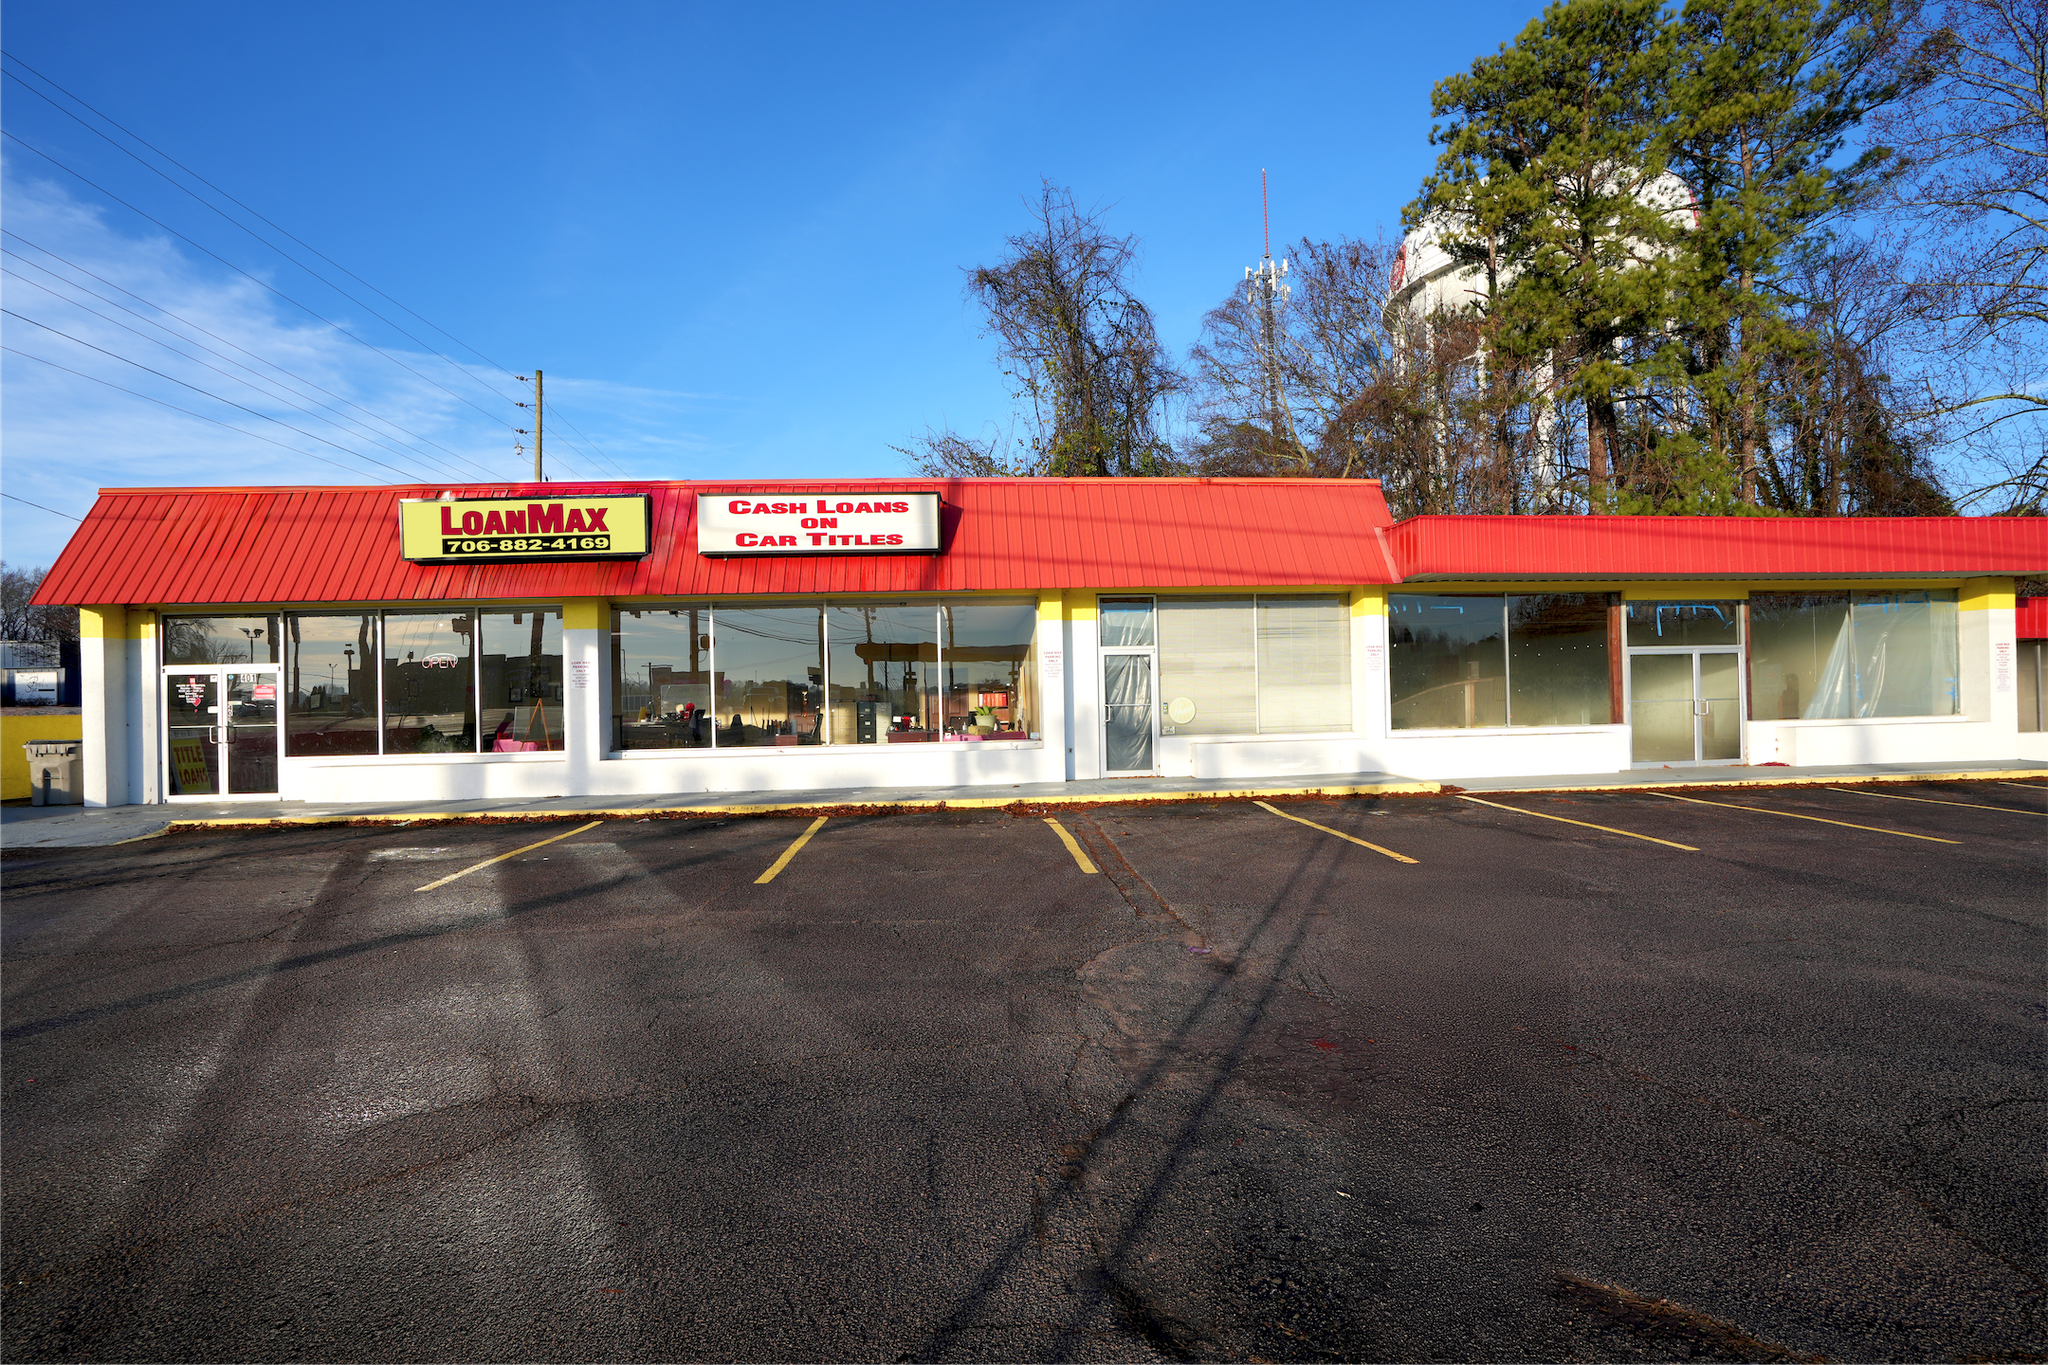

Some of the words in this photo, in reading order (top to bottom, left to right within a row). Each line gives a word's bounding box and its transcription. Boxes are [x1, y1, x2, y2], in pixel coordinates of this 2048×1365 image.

[728, 500, 807, 515] CASH
[816, 500, 909, 514] LOANS
[800, 518, 838, 529] ON
[447, 537, 609, 552] 706-882-4169
[735, 533, 798, 547] CAR
[806, 532, 904, 546] TITLES
[422, 656, 457, 669] OPEN
[241, 674, 256, 682] 401
[173, 745, 203, 764] TITLE
[178, 767, 209, 785] LOANS
